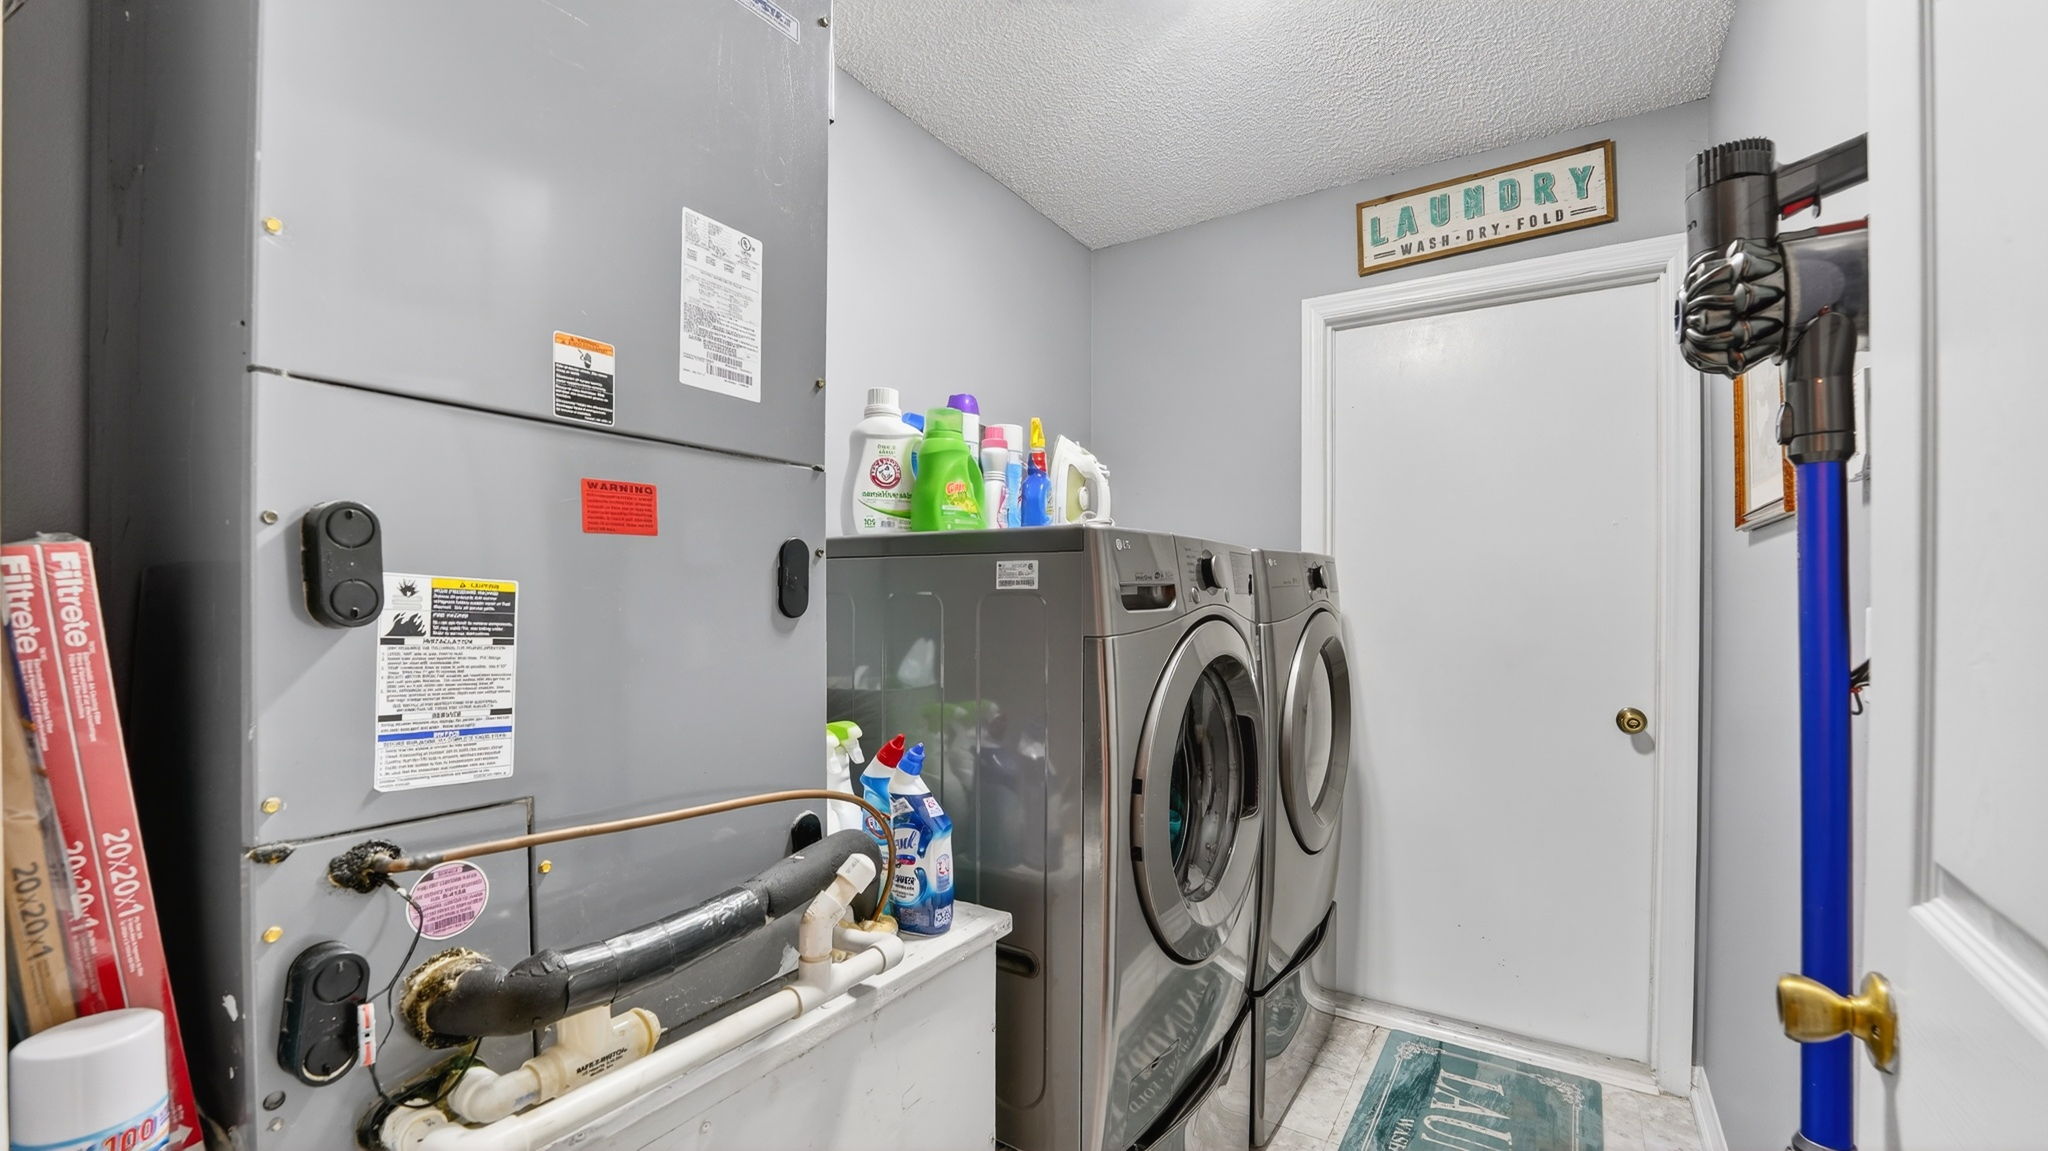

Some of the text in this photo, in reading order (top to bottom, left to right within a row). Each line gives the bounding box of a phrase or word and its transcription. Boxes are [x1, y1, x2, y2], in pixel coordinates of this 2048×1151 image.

[1370, 165, 1596, 247] LAUNDRY
[1400, 209, 1565, 256] WASH DRY FOLD
[587, 482, 654, 496] WARNING
[1, 555, 42, 654] Filtrete
[50, 551, 91, 647] Filtrete
[11, 862, 53, 962] 20x20x1
[102, 828, 145, 918] 20x20x1
